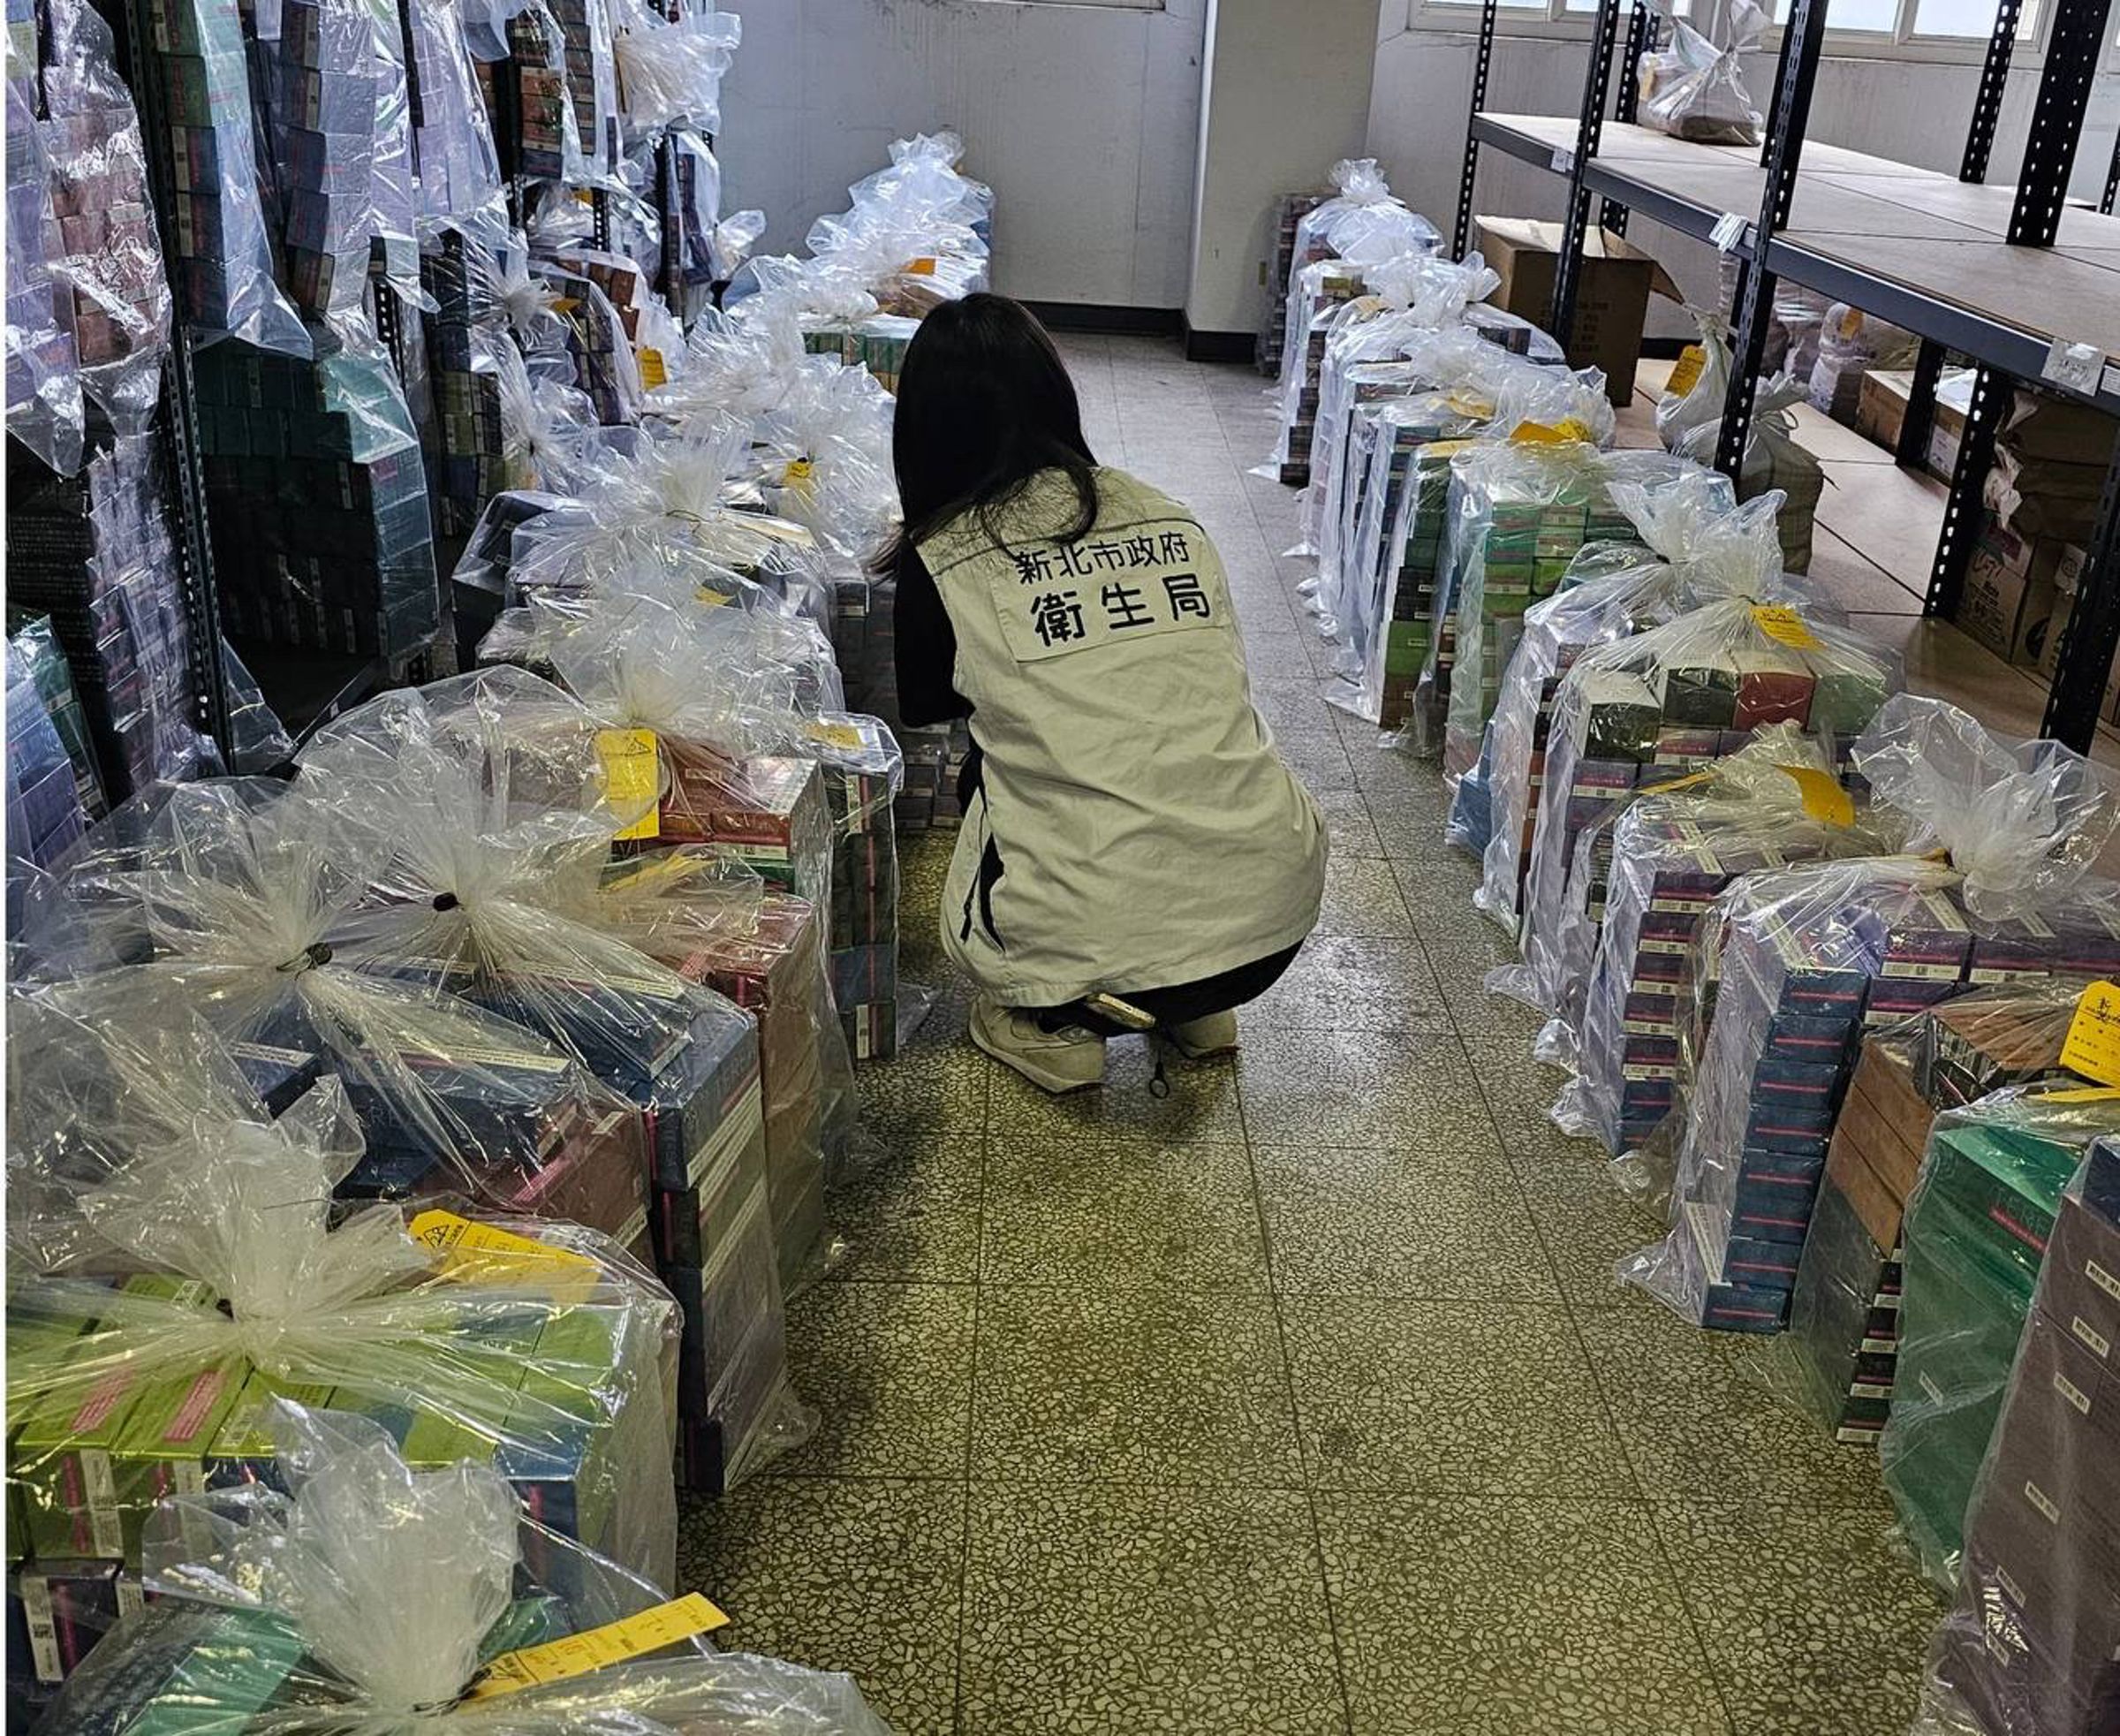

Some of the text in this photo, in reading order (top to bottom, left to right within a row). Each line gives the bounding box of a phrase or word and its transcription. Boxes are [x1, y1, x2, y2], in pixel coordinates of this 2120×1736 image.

[1015, 532, 1190, 585] 新北市政府
[1030, 573, 1210, 647] 衛生局
